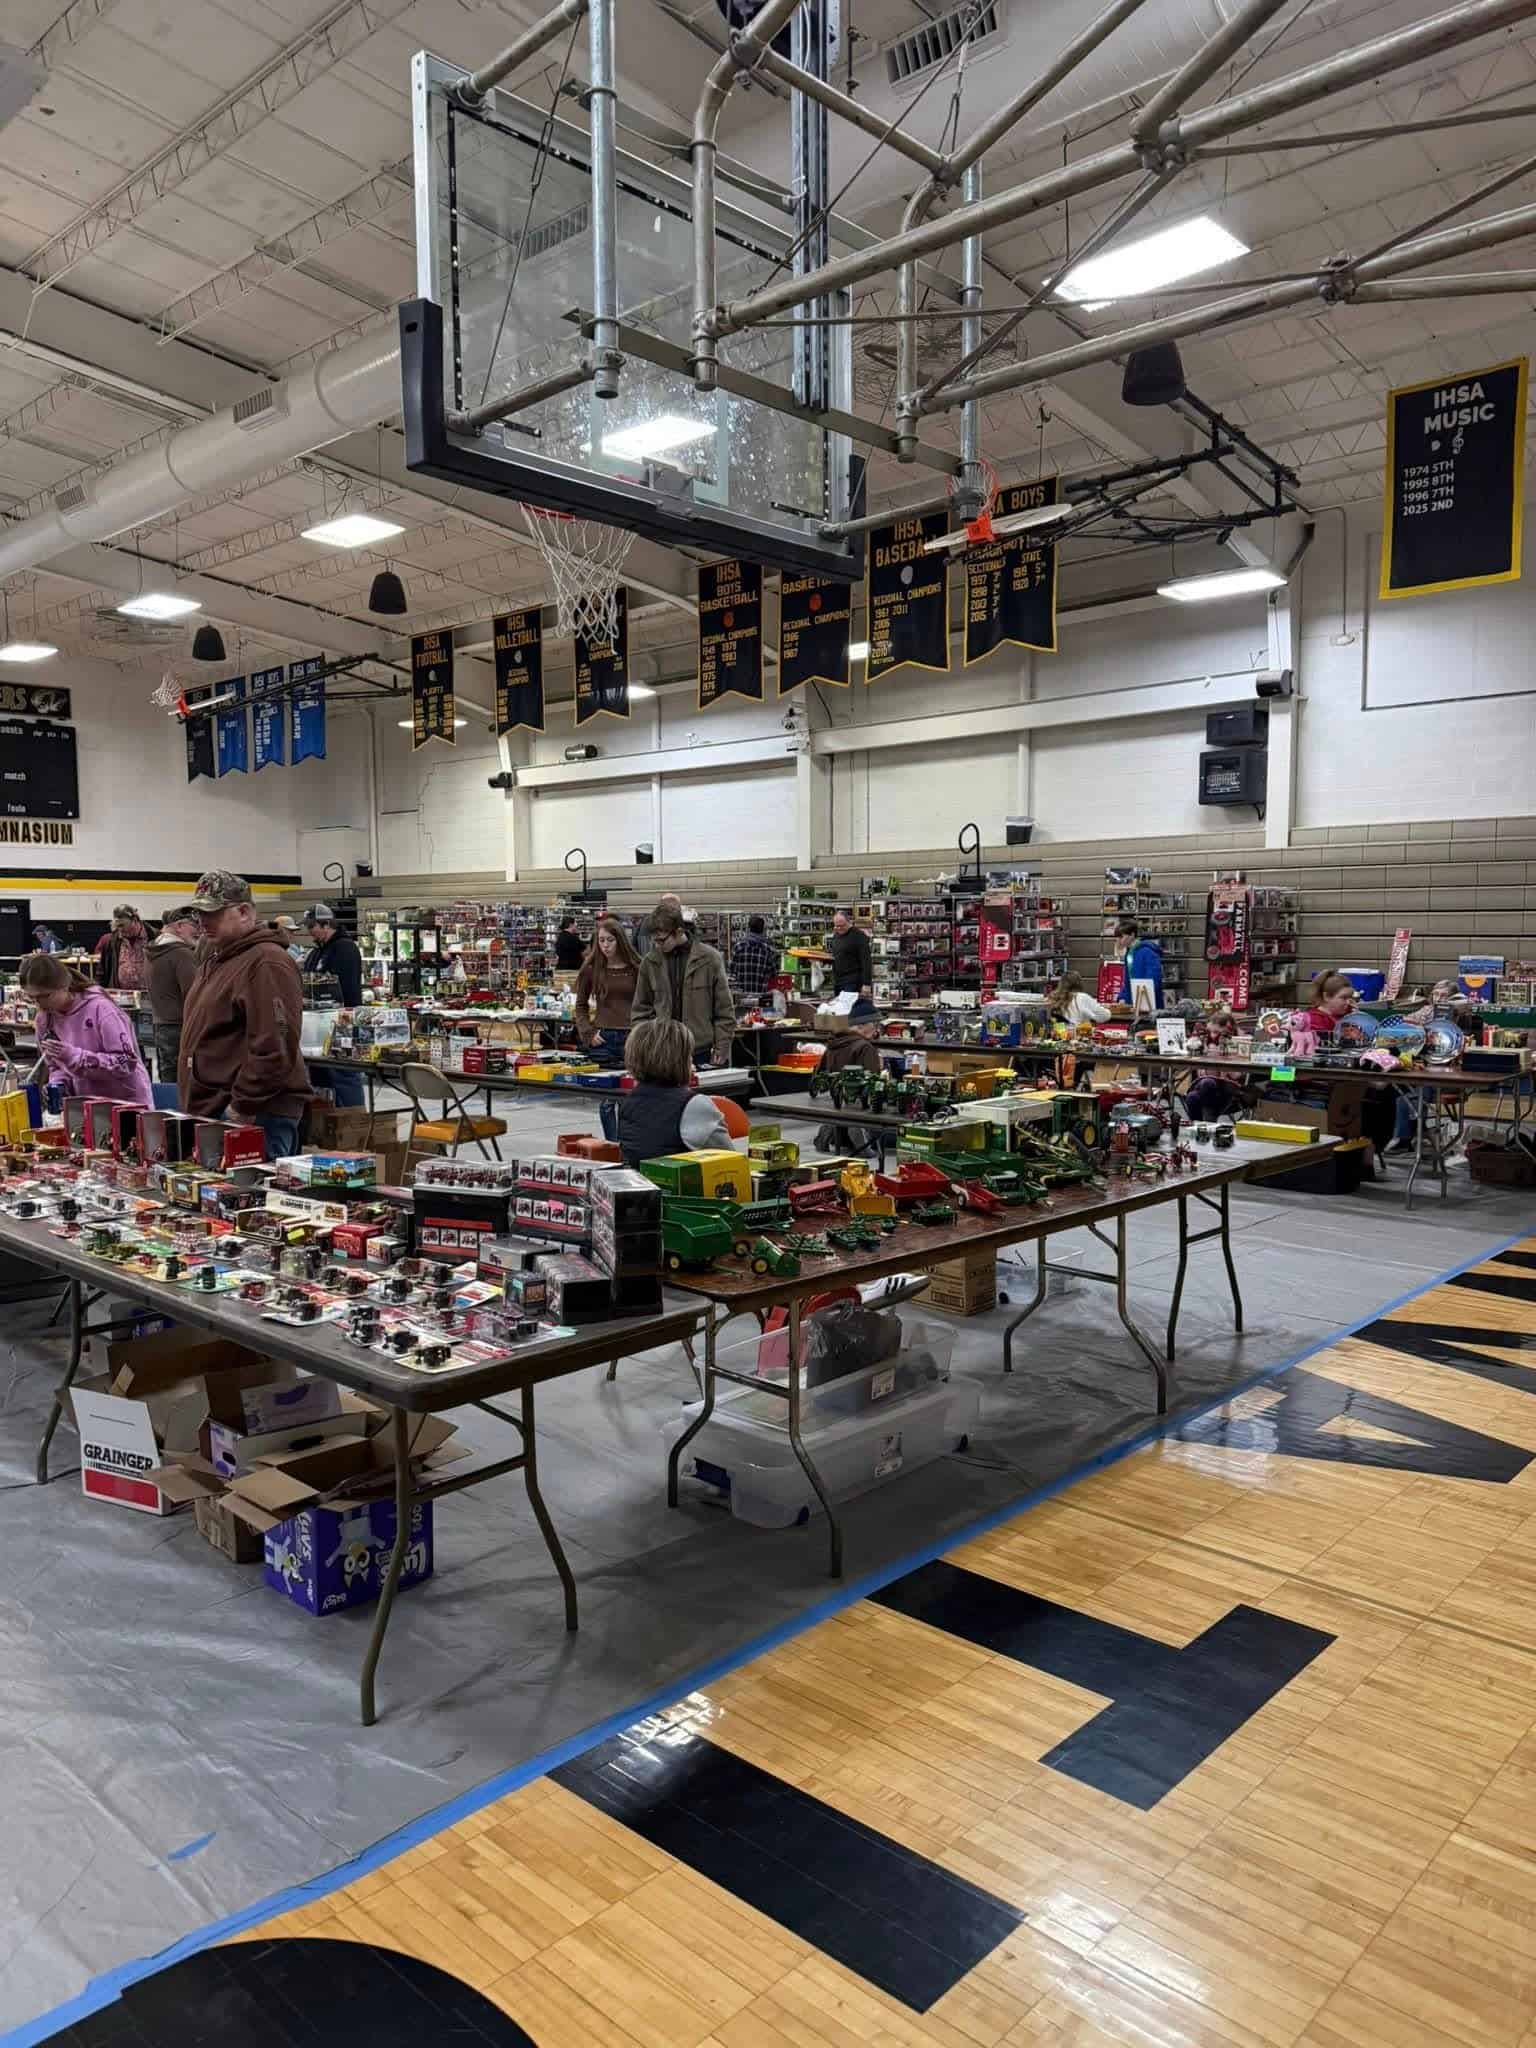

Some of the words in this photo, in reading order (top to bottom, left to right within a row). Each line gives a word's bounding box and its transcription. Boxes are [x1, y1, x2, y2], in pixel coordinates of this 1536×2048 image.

[1434, 382, 1485, 409] IHSA
[1424, 403, 1496, 434] MUSIC
[1403, 465, 1430, 479] 1974
[1432, 459, 1454, 473] 5TH
[1403, 478, 1430, 491] 1995
[1432, 472, 1455, 486] 8TH
[1010, 486, 1045, 510] BOYS
[1403, 491, 1429, 504] 1996
[1432, 485, 1455, 498] 7TH
[1403, 503, 1428, 516] 2025
[1431, 498, 1453, 511] 2ND
[893, 519, 924, 542] IHSA
[716, 561, 742, 583] IHSA
[716, 581, 742, 597] BOYS
[873, 591, 904, 607] REGIONAL
[907, 582, 942, 600] CHAMPIONS
[700, 590, 759, 613] BASKETBALL
[496, 627, 539, 650] VOLLEYBALL
[416, 648, 449, 669] FOOTBALL
[84, 1443, 154, 1471] GRAINGER
